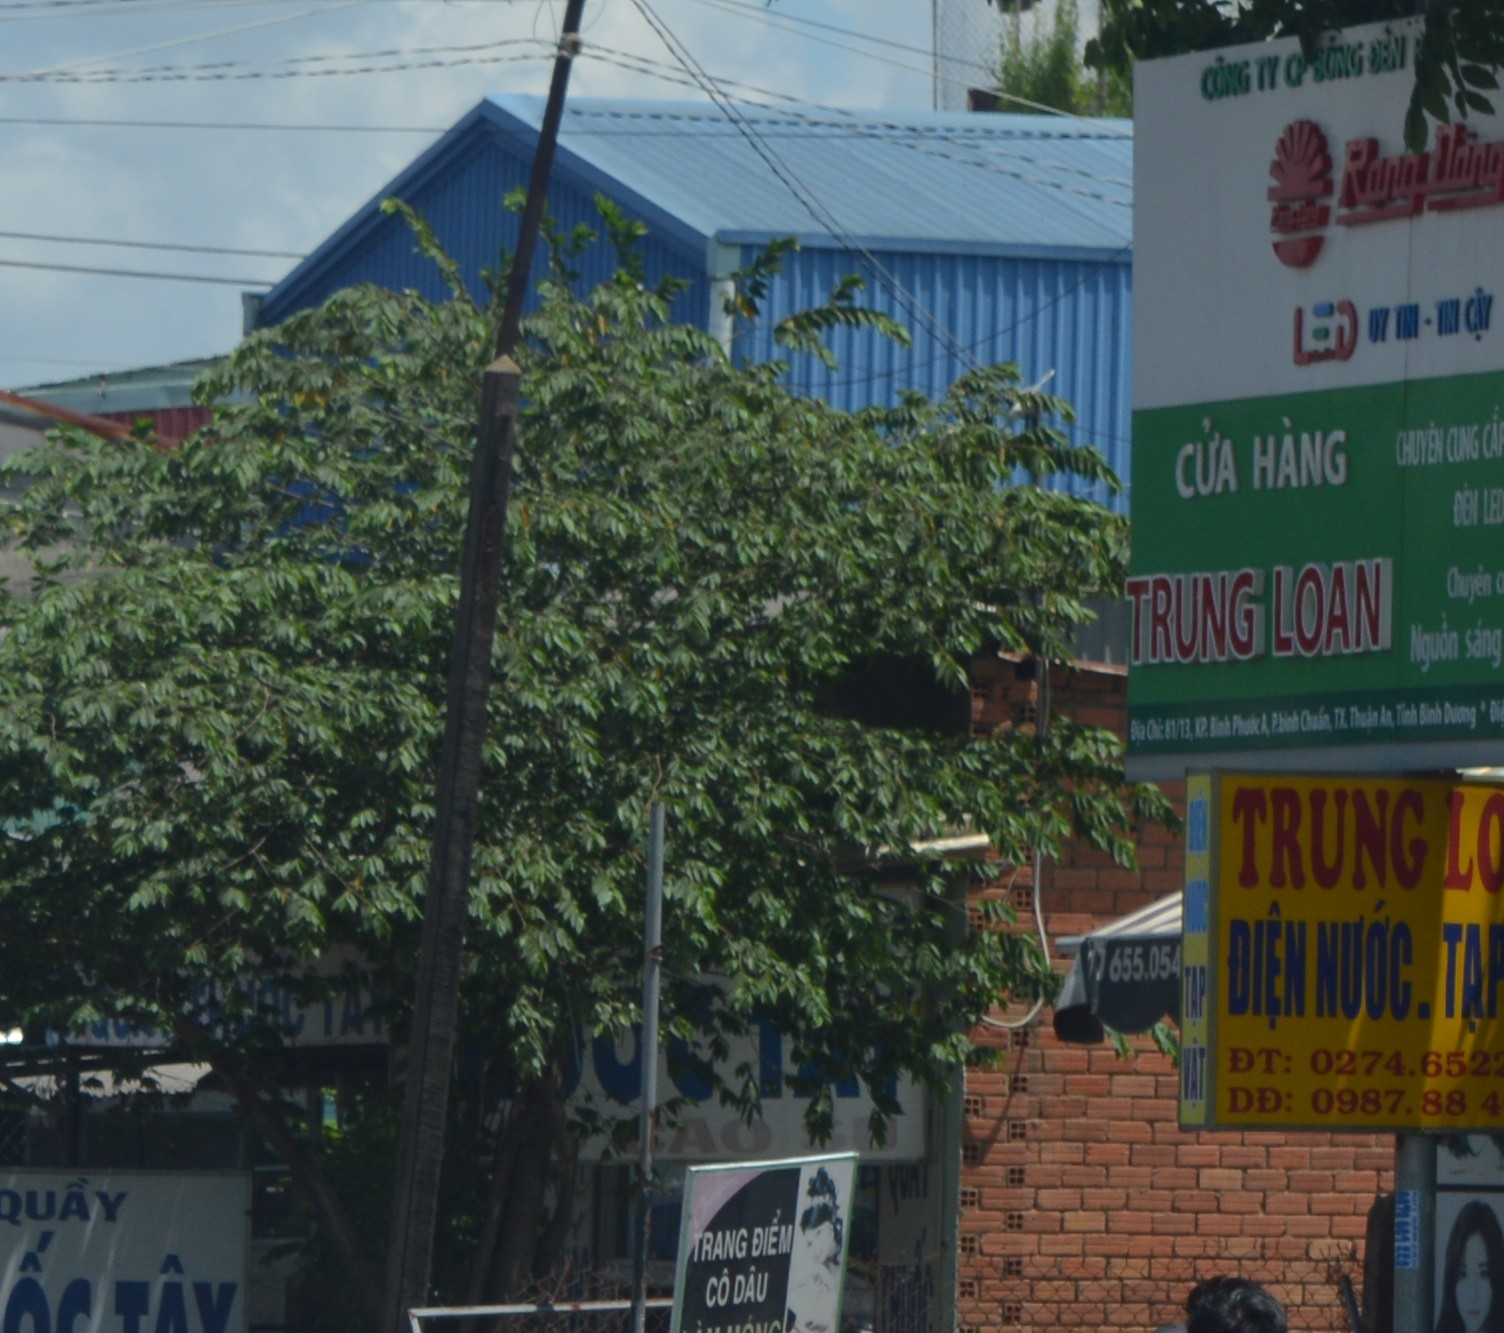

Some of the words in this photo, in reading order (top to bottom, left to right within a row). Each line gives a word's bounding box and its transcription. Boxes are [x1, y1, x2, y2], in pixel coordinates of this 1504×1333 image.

[1176, 418, 1240, 500] CỬA
[1252, 419, 1349, 490] HÀNG
[1126, 567, 1266, 666] TRUNG
[1272, 557, 1392, 659] LOAN
[1232, 786, 1429, 891] TRUNG
[1227, 900, 1307, 1030] ĐIỆN
[1316, 899, 1413, 1021] NƯỚC
[1227, 1047, 1292, 1076] ĐT:
[1227, 1086, 1293, 1114] DĐ:
[1310, 1087, 1468, 1117] 0987.88
[692, 1226, 748, 1264] TRANG
[751, 1208, 793, 1258] ĐIỂM
[705, 1270, 731, 1308] CÔ
[733, 1263, 769, 1304] DÂU
